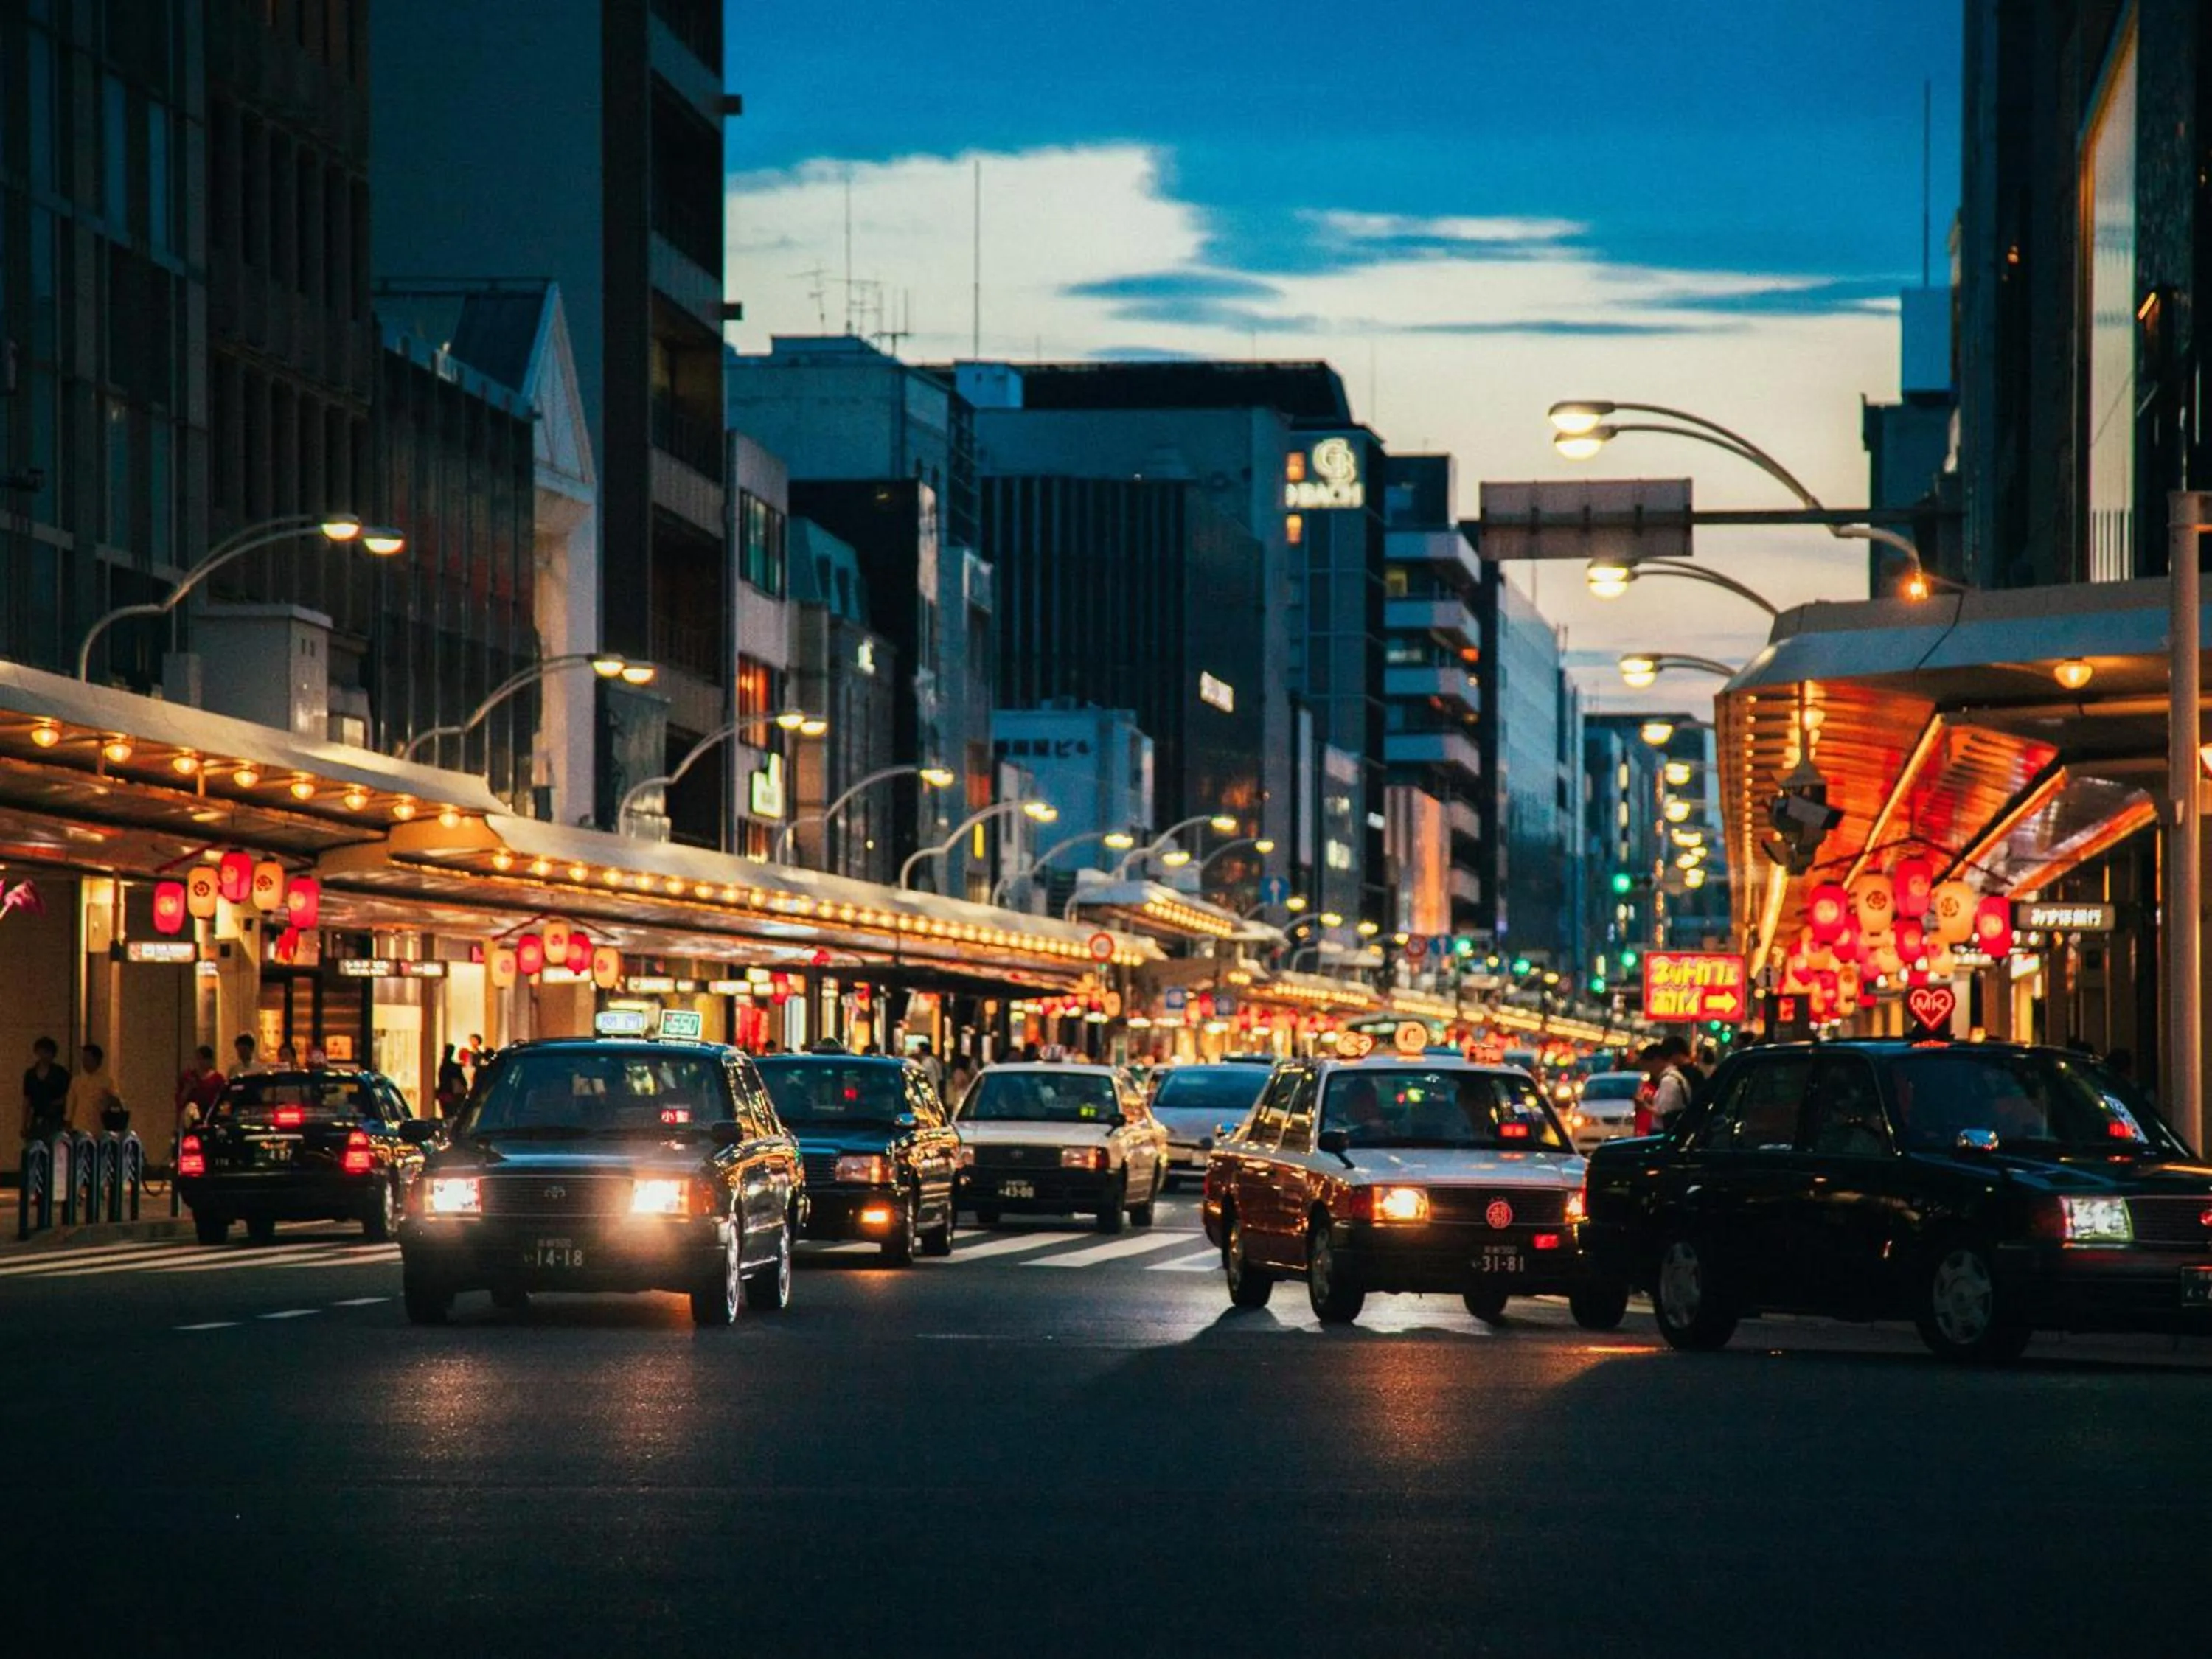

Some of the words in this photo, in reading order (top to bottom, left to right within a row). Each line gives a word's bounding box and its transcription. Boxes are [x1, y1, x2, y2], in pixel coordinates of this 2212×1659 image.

[1916, 996, 1946, 1012] MK
[537, 1249, 582, 1267] 14-18
[1482, 1255, 1525, 1272] 31-81
